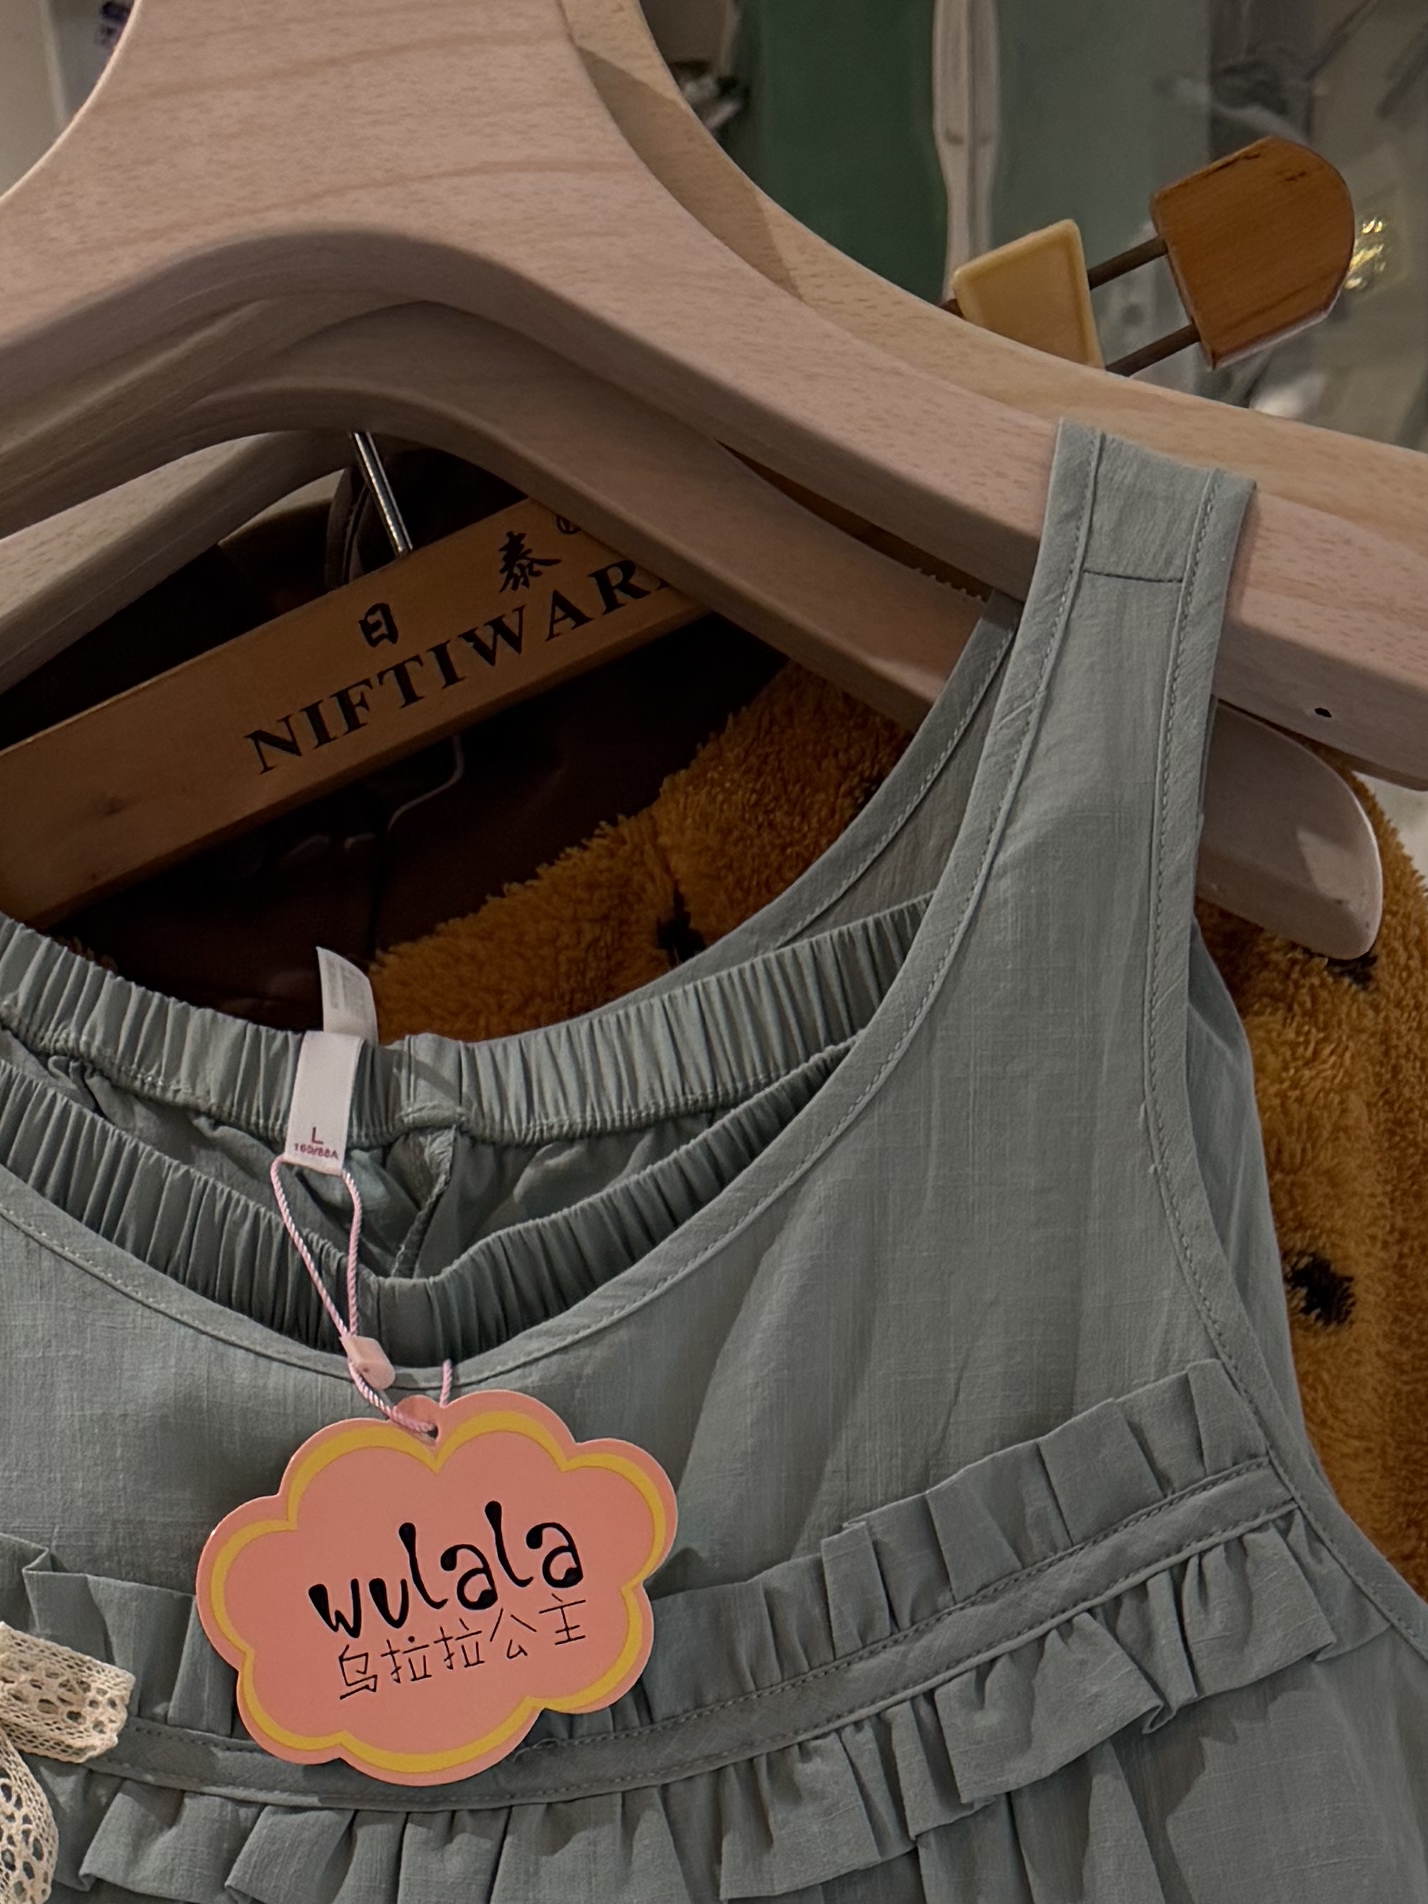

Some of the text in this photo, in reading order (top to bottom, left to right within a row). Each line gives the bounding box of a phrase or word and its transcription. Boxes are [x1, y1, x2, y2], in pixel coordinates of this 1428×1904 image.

[245, 559, 671, 776] NIFTIWAR
[311, 1126, 324, 1145] L
[308, 1500, 585, 1639] wulala
[338, 1594, 587, 1700] 乌拉拉公主
